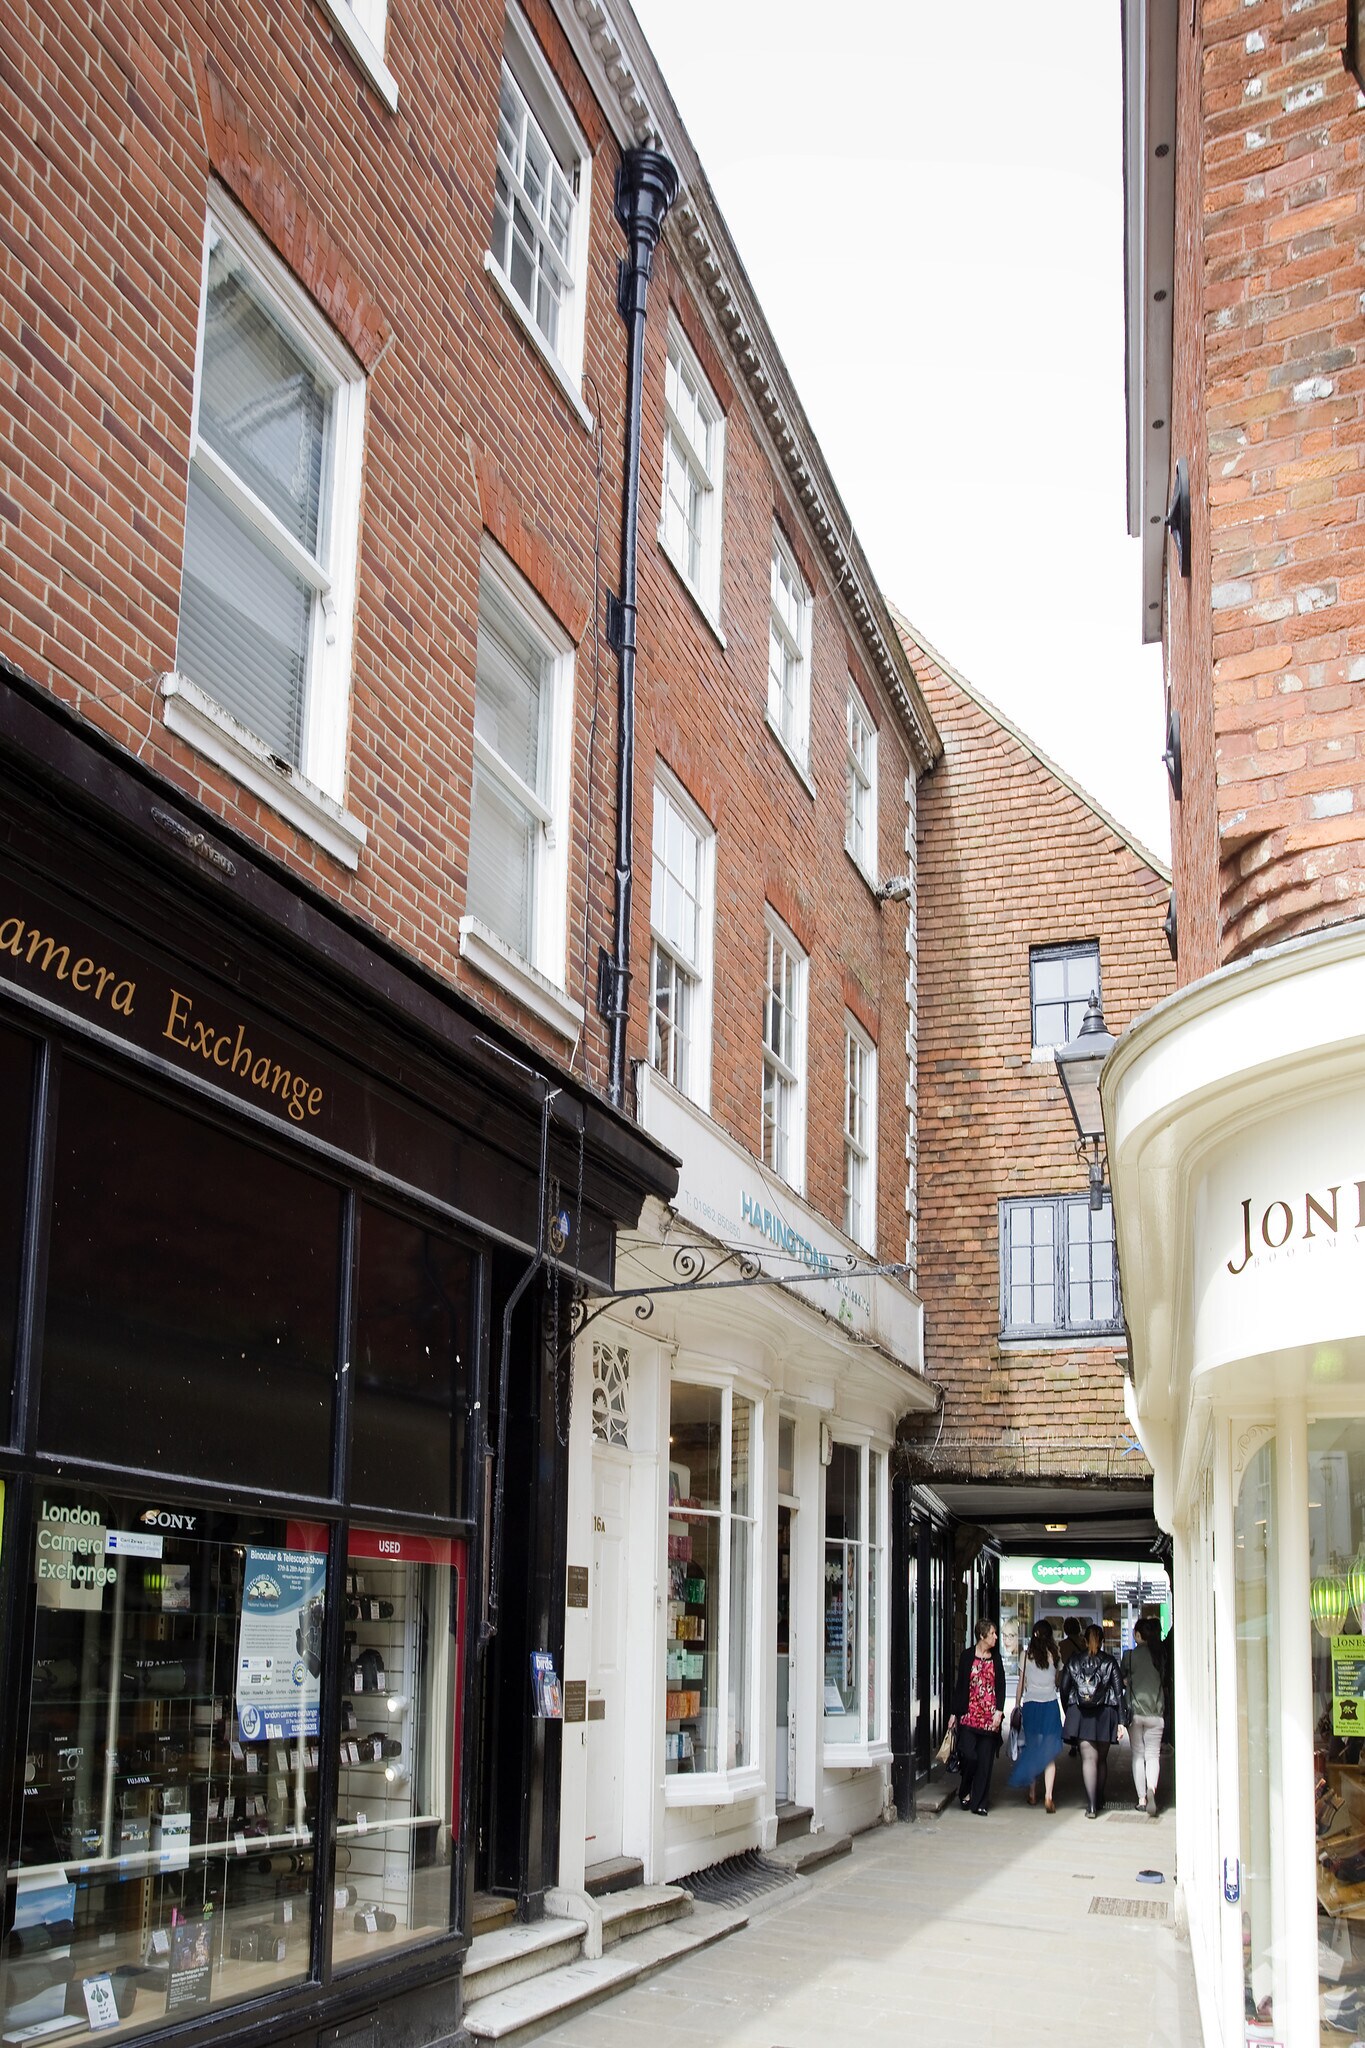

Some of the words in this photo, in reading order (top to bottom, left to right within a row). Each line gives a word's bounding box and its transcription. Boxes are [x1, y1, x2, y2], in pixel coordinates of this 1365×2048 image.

[162, 988, 324, 1121] Exchange
[42, 1501, 100, 1525] London
[145, 1510, 197, 1530] SONY
[594, 1516, 605, 1533] 16A
[38, 1529, 103, 1555] Camera
[379, 1540, 401, 1554] USED
[250, 1550, 277, 1561] Binocular
[277, 1552, 283, 1562] &
[283, 1553, 309, 1565] Telescope
[309, 1555, 324, 1565] Show
[38, 1558, 117, 1587] Exchange
[1037, 1564, 1086, 1577] Specsavers
[535, 1655, 553, 1670] birds
[264, 1710, 281, 1719] london
[127, 1776, 150, 1785] FUJIFILM
